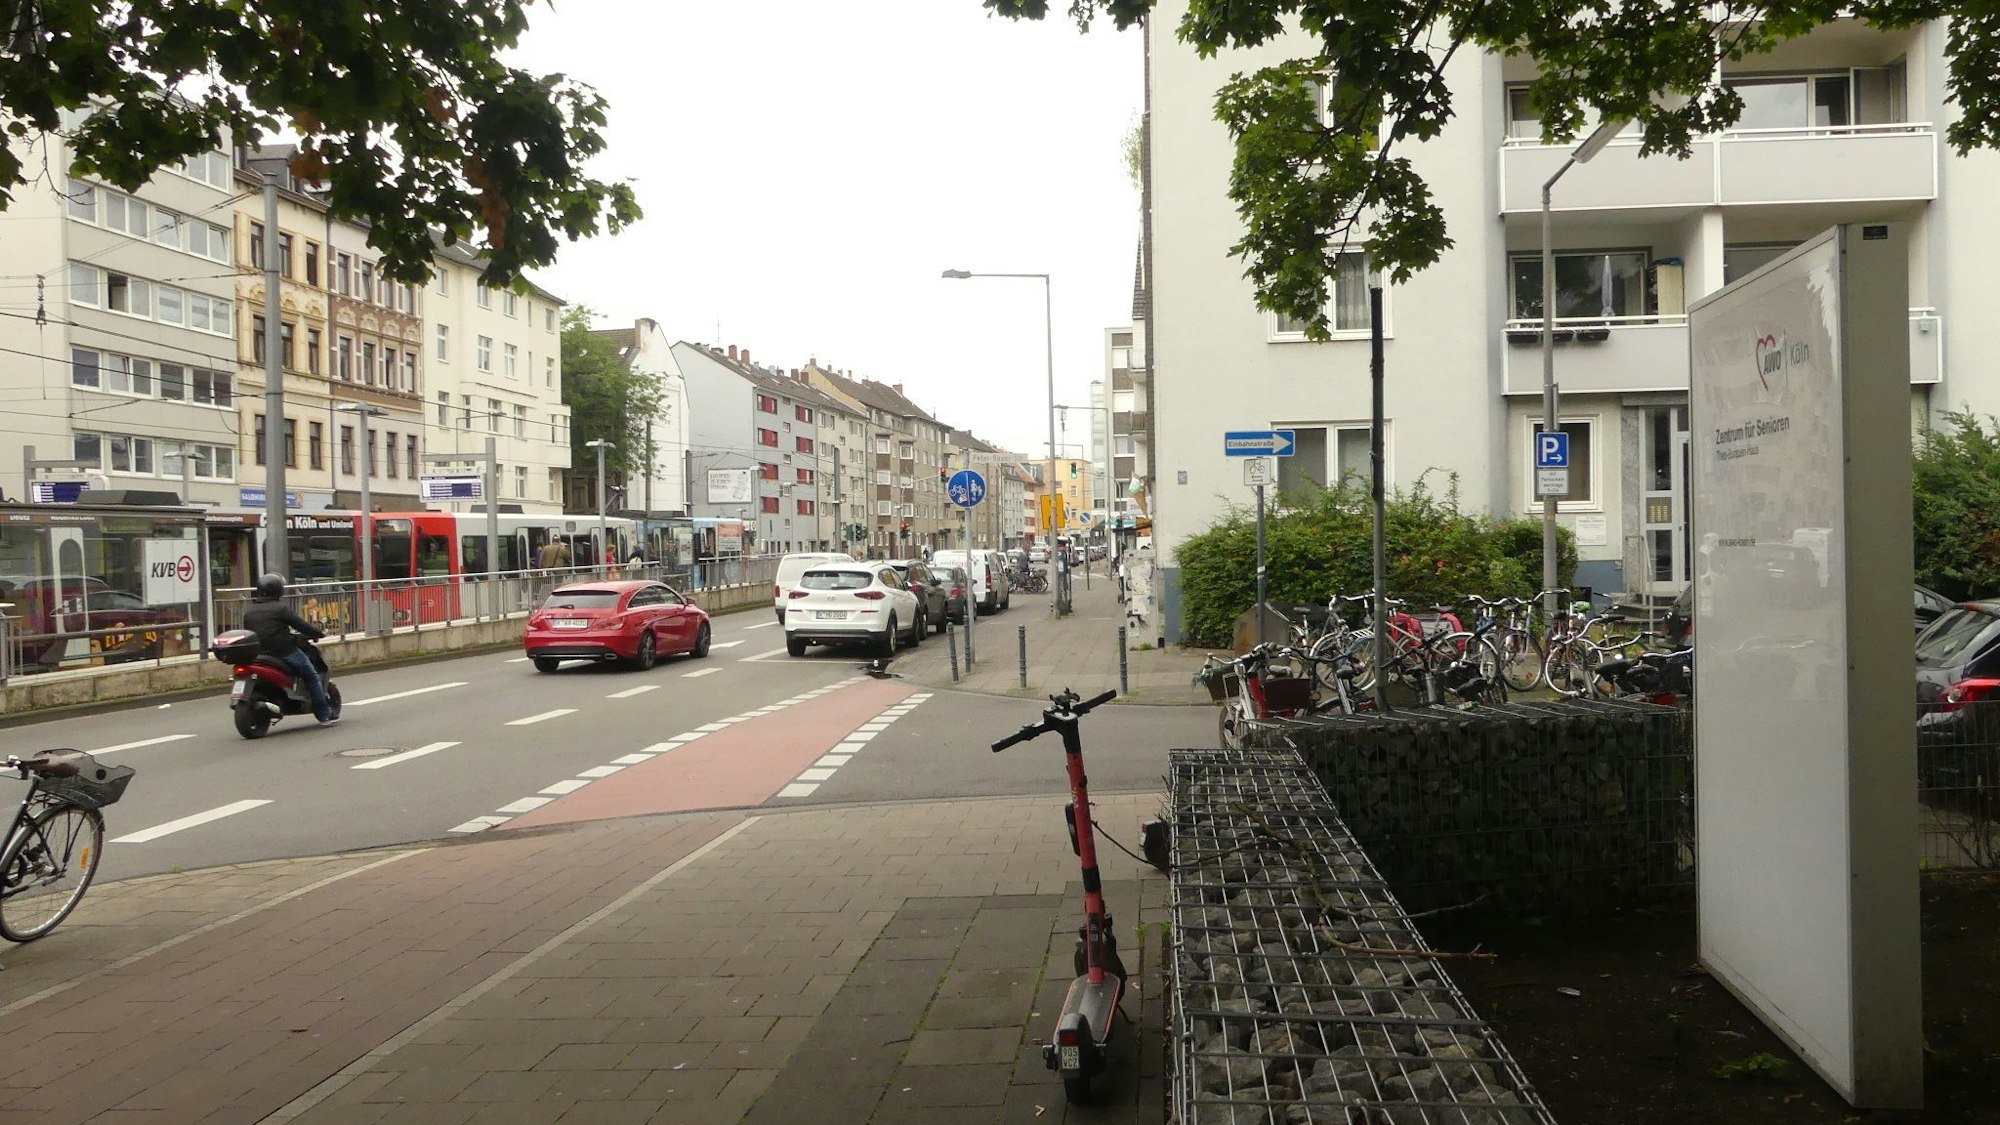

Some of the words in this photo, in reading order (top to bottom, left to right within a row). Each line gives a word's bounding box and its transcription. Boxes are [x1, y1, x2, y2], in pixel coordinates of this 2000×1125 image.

[1763, 350, 1781, 375] AWO
[1790, 341, 1810, 366] Köln
[1715, 428, 1744, 445] Zentrum
[1744, 421, 1755, 438] für
[1756, 415, 1790, 436] Senioren
[1228, 440, 1275, 448] Einbahnstraße
[1542, 437, 1559, 462] P
[295, 515, 318, 529] Köln
[319, 519, 331, 529] und
[331, 519, 354, 529] Umland
[151, 562, 176, 578] KVB
[1063, 1047, 1078, 1056] 905
